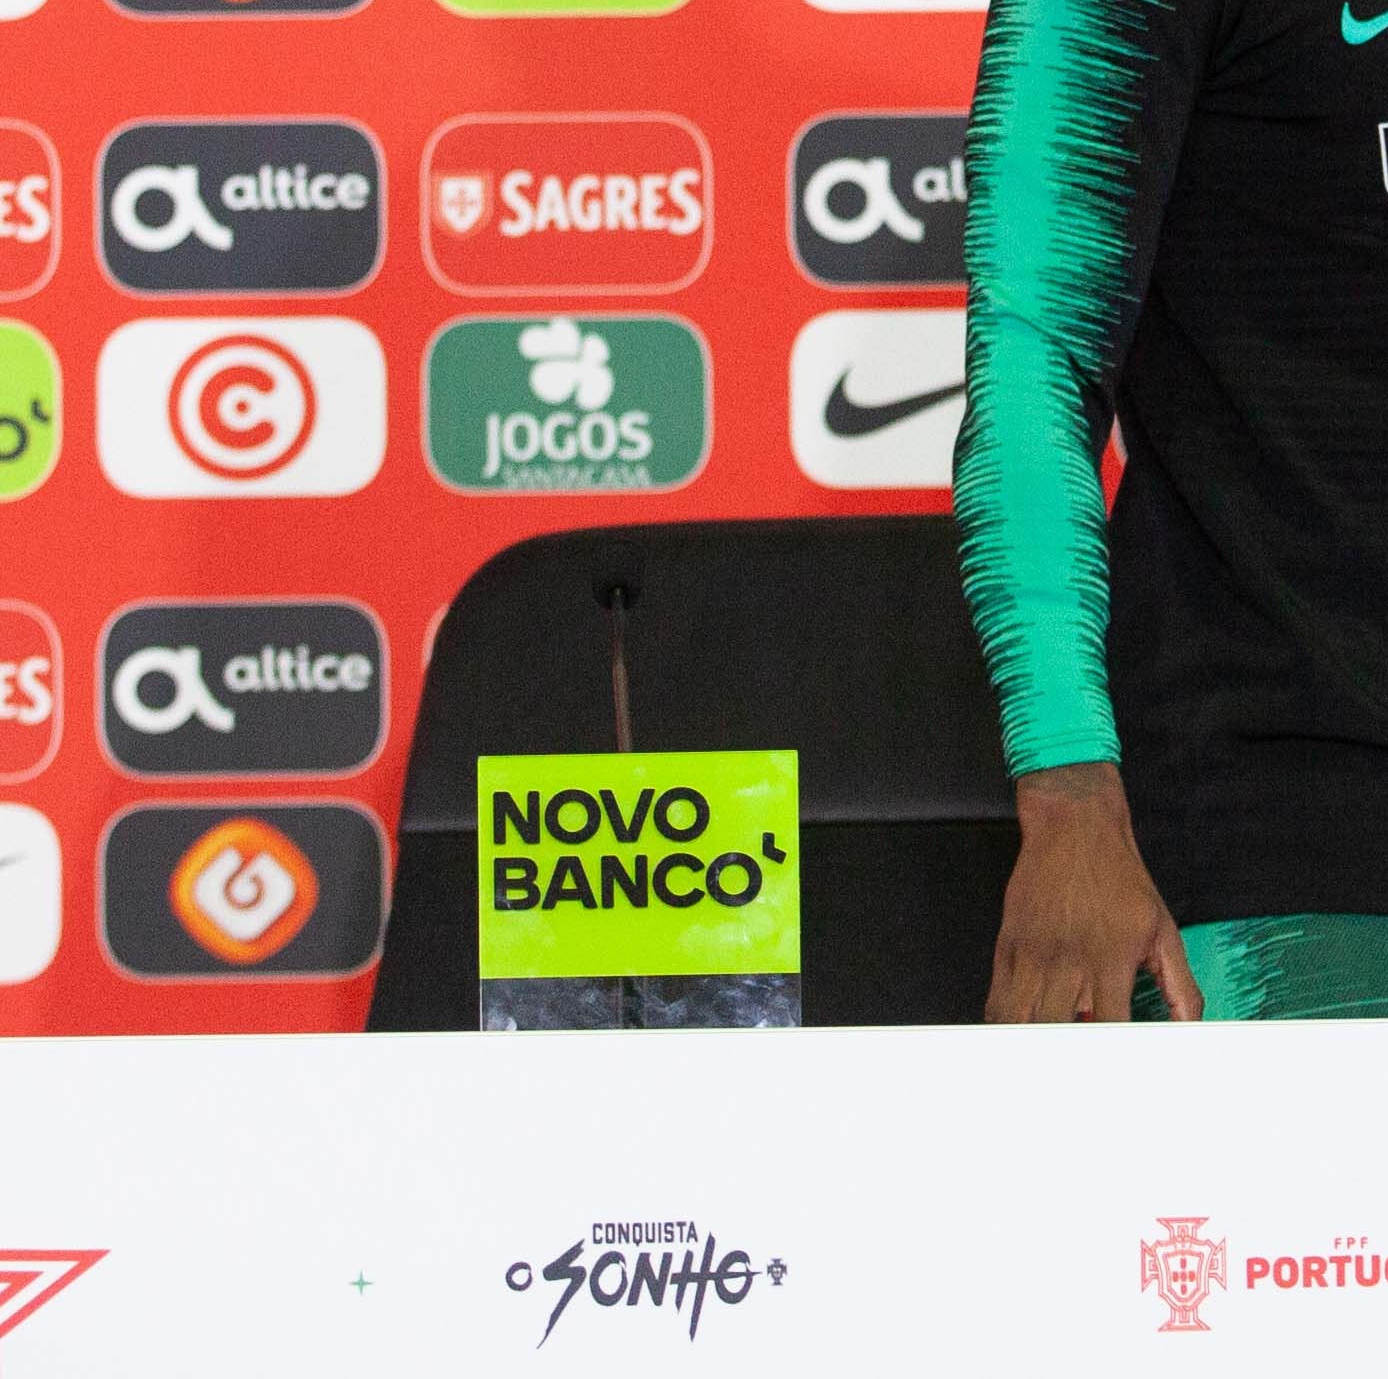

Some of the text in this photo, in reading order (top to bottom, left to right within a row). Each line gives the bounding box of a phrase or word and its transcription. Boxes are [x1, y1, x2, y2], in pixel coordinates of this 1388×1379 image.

[221, 164, 370, 211] altice
[500, 168, 703, 238] SAGRES
[481, 409, 653, 479] JOGOS
[223, 646, 372, 692] altice
[492, 786, 711, 846] NOVO
[492, 852, 763, 912] BANCO
[592, 1220, 699, 1246] CONQUISTA
[1333, 1236, 1368, 1250] FPF
[504, 1261, 533, 1292] O
